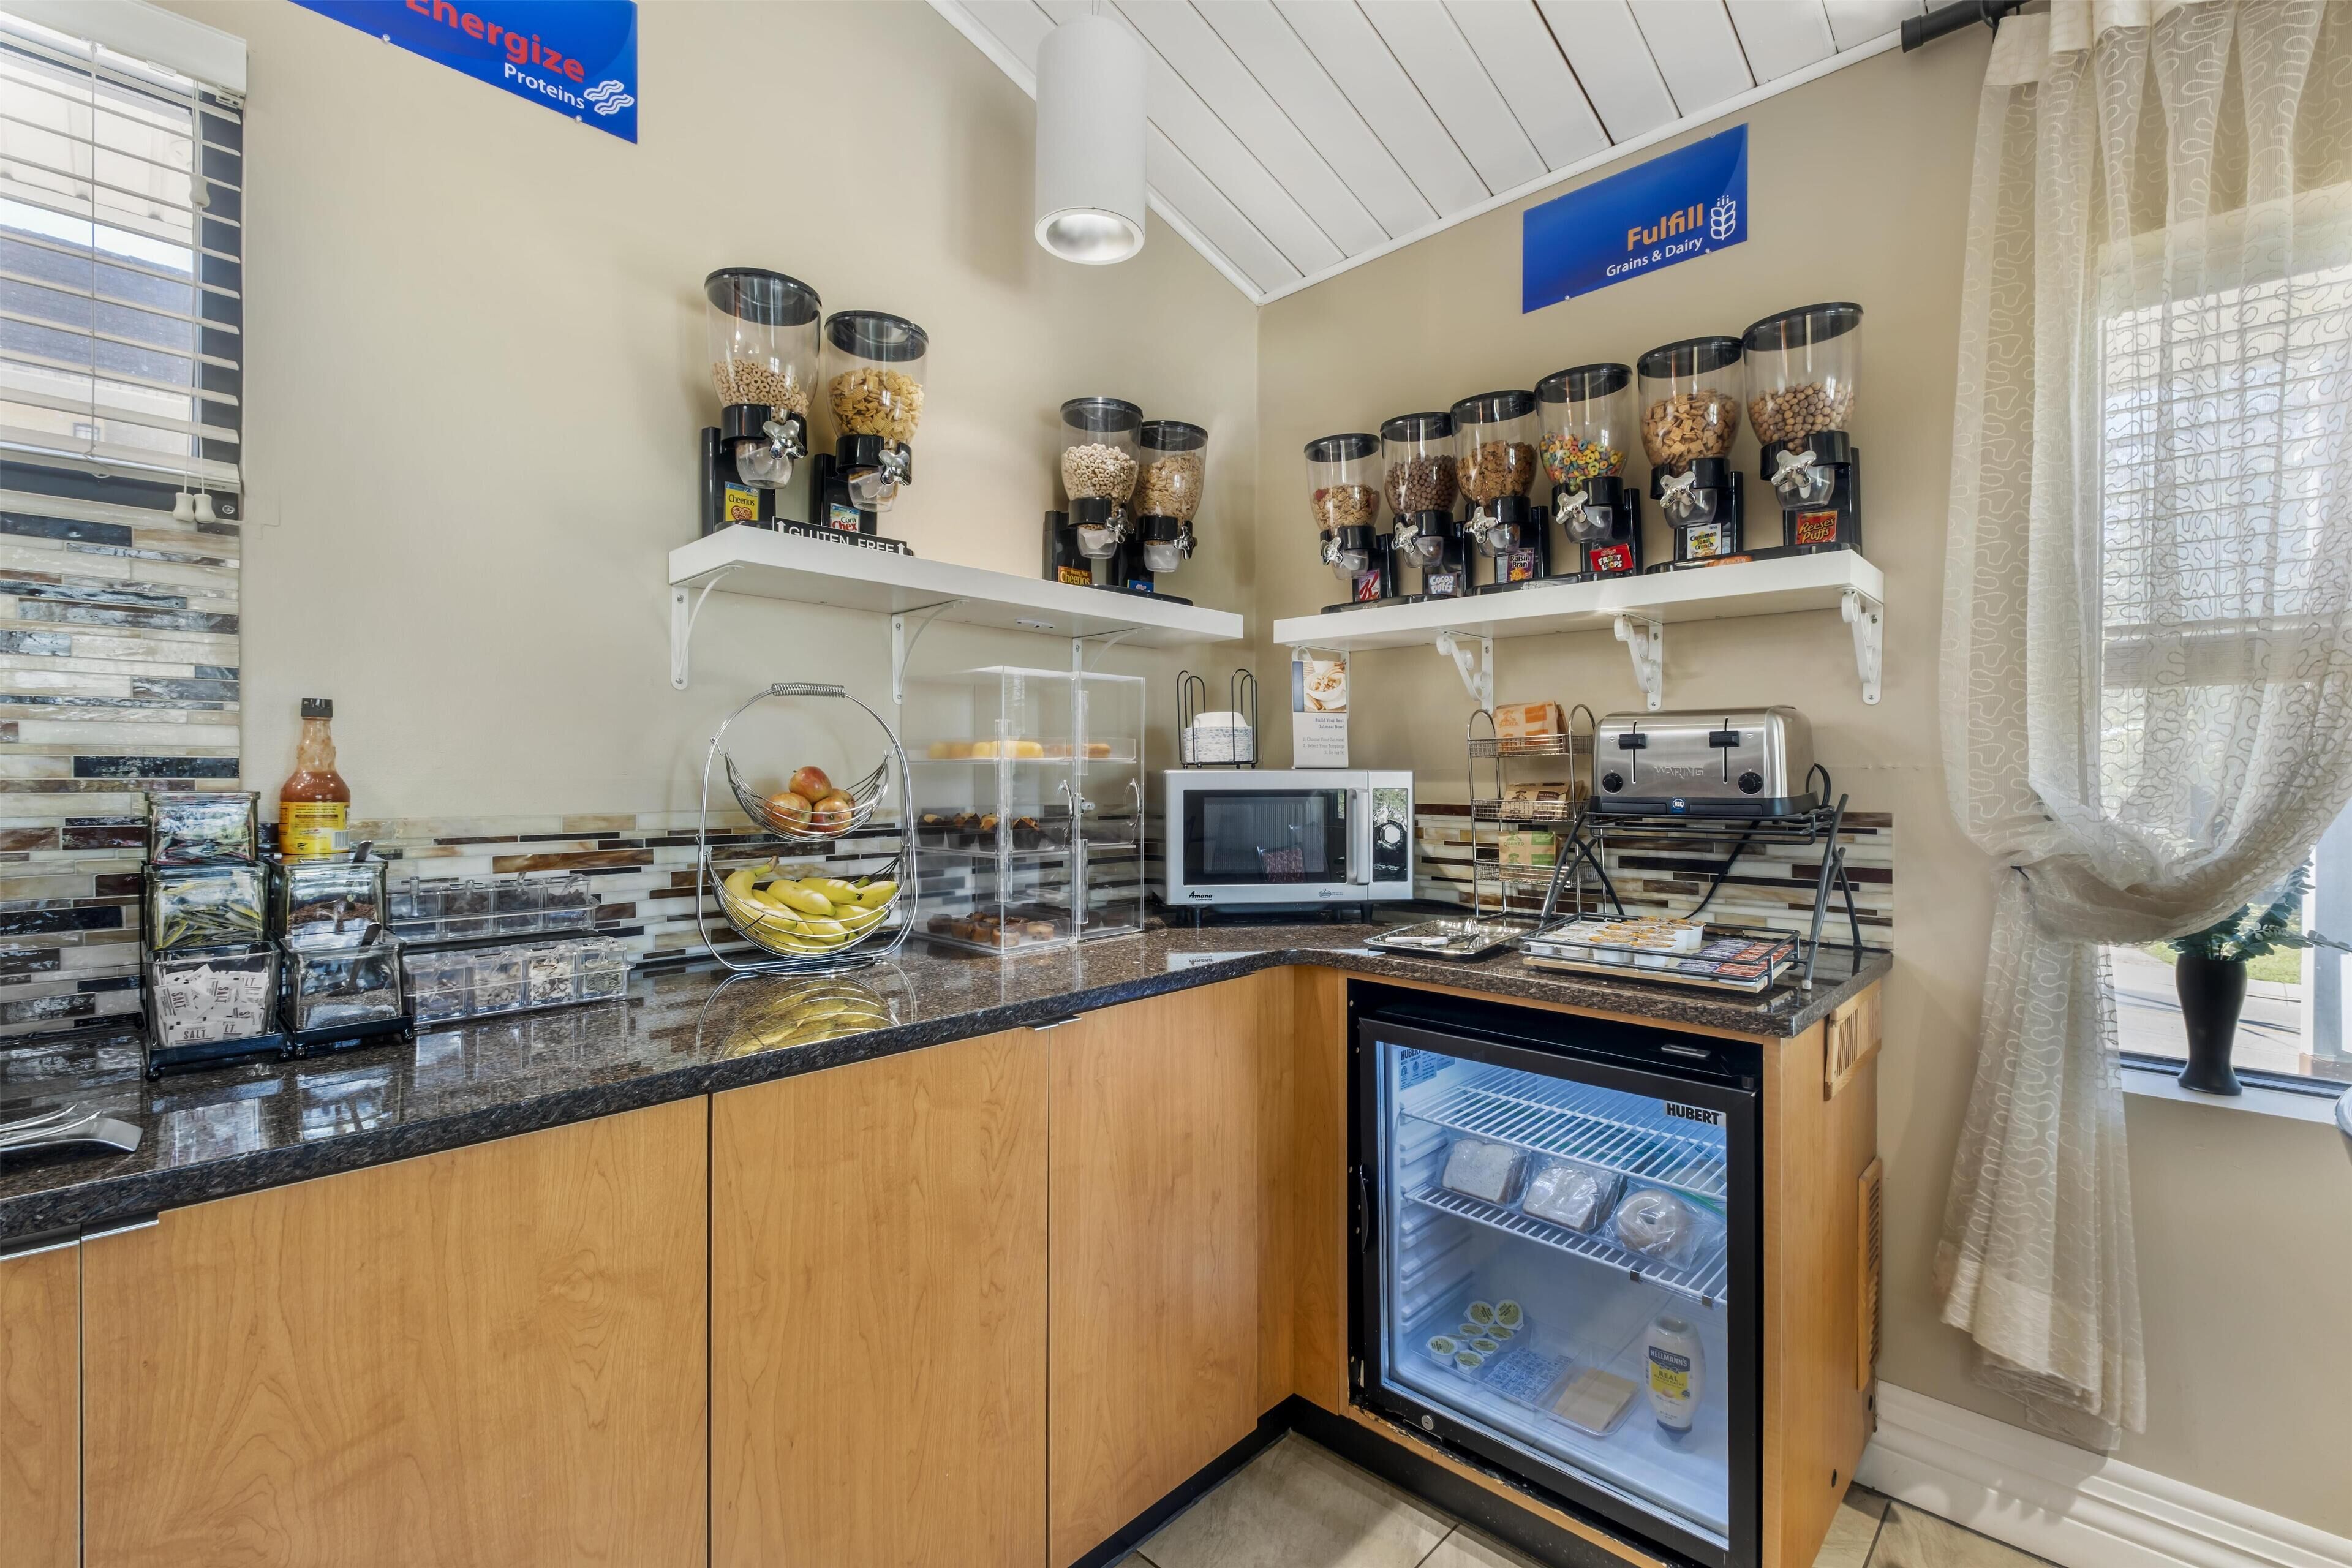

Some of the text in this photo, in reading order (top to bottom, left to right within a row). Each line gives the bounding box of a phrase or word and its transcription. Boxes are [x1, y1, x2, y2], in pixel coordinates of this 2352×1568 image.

[504, 62, 585, 109] Proteins
[1627, 203, 1704, 252] Fulfill
[1606, 237, 1703, 277] Grains & Dairy
[728, 494, 755, 507] Cheerios
[832, 521, 858, 531] Chex
[1691, 532, 1717, 541] Cinnamon
[1801, 527, 1829, 544] Puffs
[1597, 554, 1622, 565] FROOT
[1601, 561, 1623, 571] LOOPS
[1060, 570, 1090, 586] Cheerios
[1654, 766, 1703, 780] WARING
[172, 992, 186, 1009] SALT
[215, 986, 229, 1004] SALT
[183, 1029, 206, 1039] SALT
[223, 1022, 236, 1033] LT
[1667, 1102, 1719, 1125] HUBERT
[1651, 1349, 1687, 1367] HELLMANN'S
[1659, 1370, 1679, 1382] REAL
